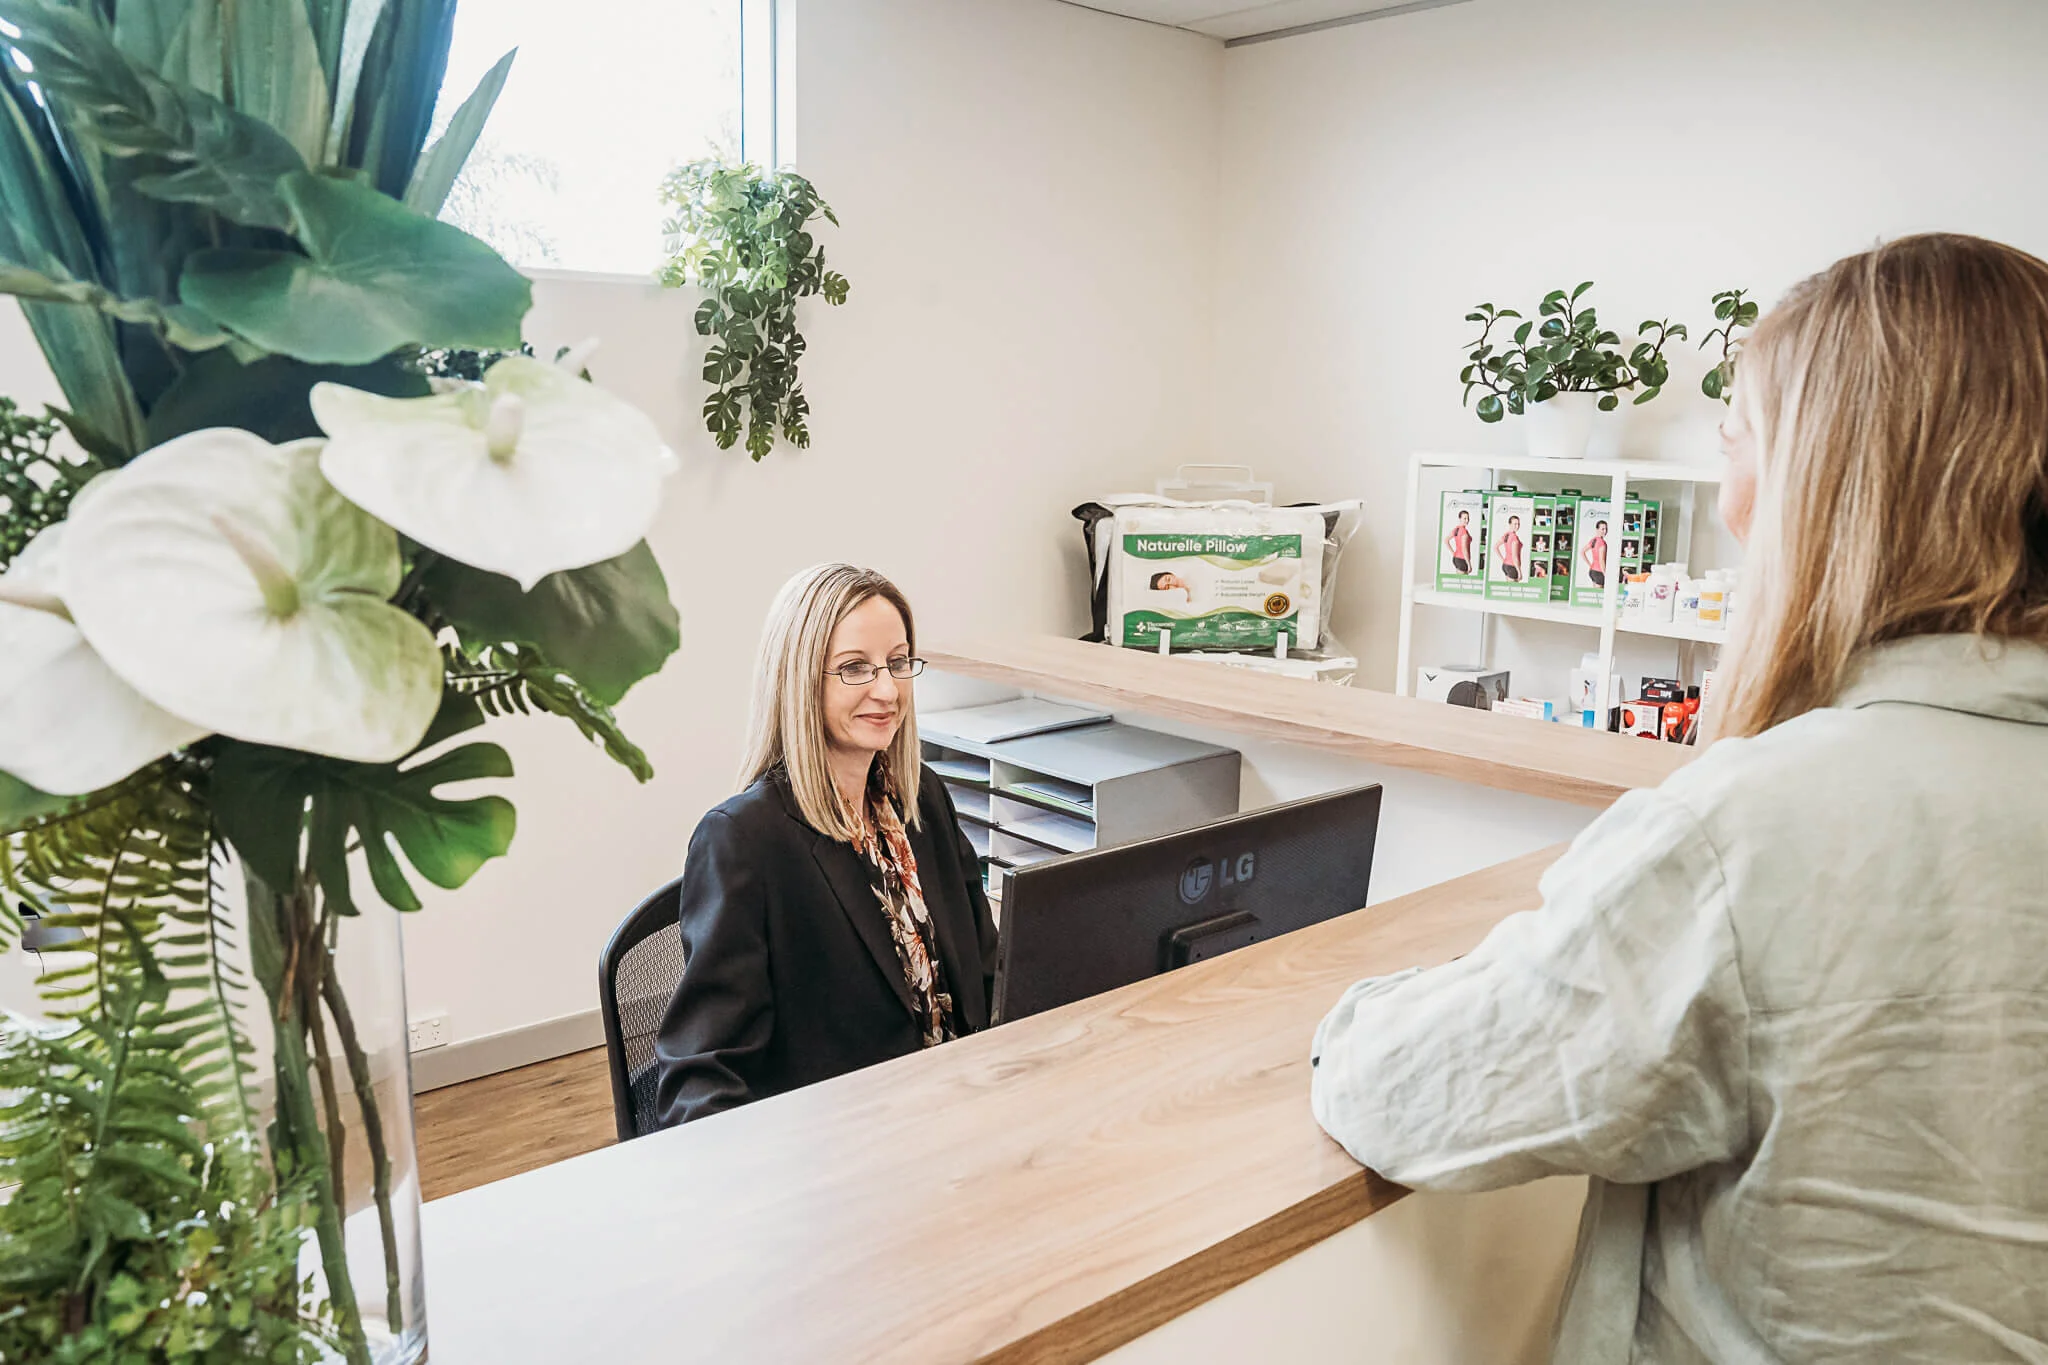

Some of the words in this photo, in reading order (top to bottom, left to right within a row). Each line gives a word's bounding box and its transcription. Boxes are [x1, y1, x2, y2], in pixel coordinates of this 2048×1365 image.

[1137, 539, 1202, 552] Naturelle
[1206, 540, 1248, 553] Pillow
[1220, 852, 1255, 888] LG
